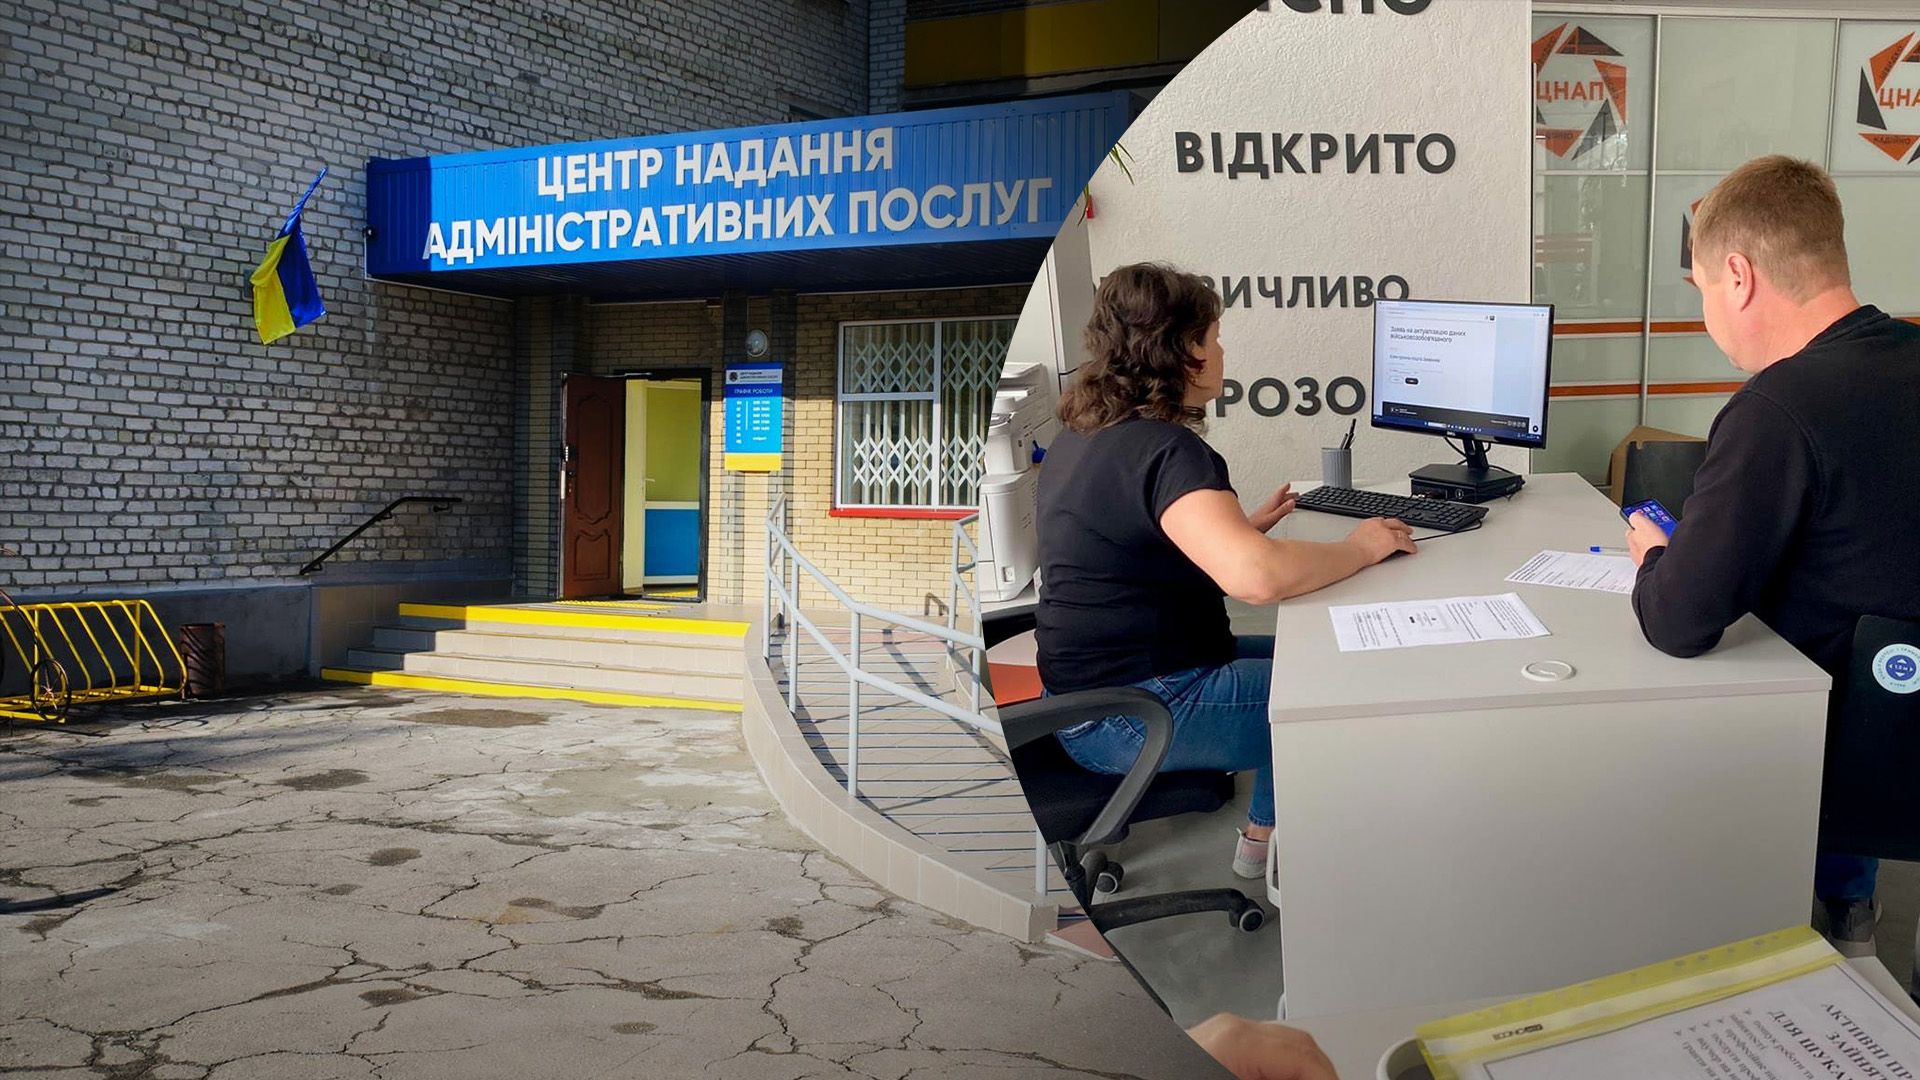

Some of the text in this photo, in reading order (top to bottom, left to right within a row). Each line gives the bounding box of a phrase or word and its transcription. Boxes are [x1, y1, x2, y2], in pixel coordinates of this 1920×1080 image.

[1537, 81, 1604, 103] ЦНАП
[537, 127, 894, 201] ЦЕНТР НАДАННЯ
[1174, 131, 1456, 179] ВІДКРИТО
[422, 177, 1053, 265] АДМІНІСТРАТИВНИХ ПОСЛУГ
[1215, 376, 1366, 417] РОЗО
[1767, 1010, 1854, 1080] ДЛЯ ШУКА
[1821, 1004, 1889, 1060] АКТИВНІ
